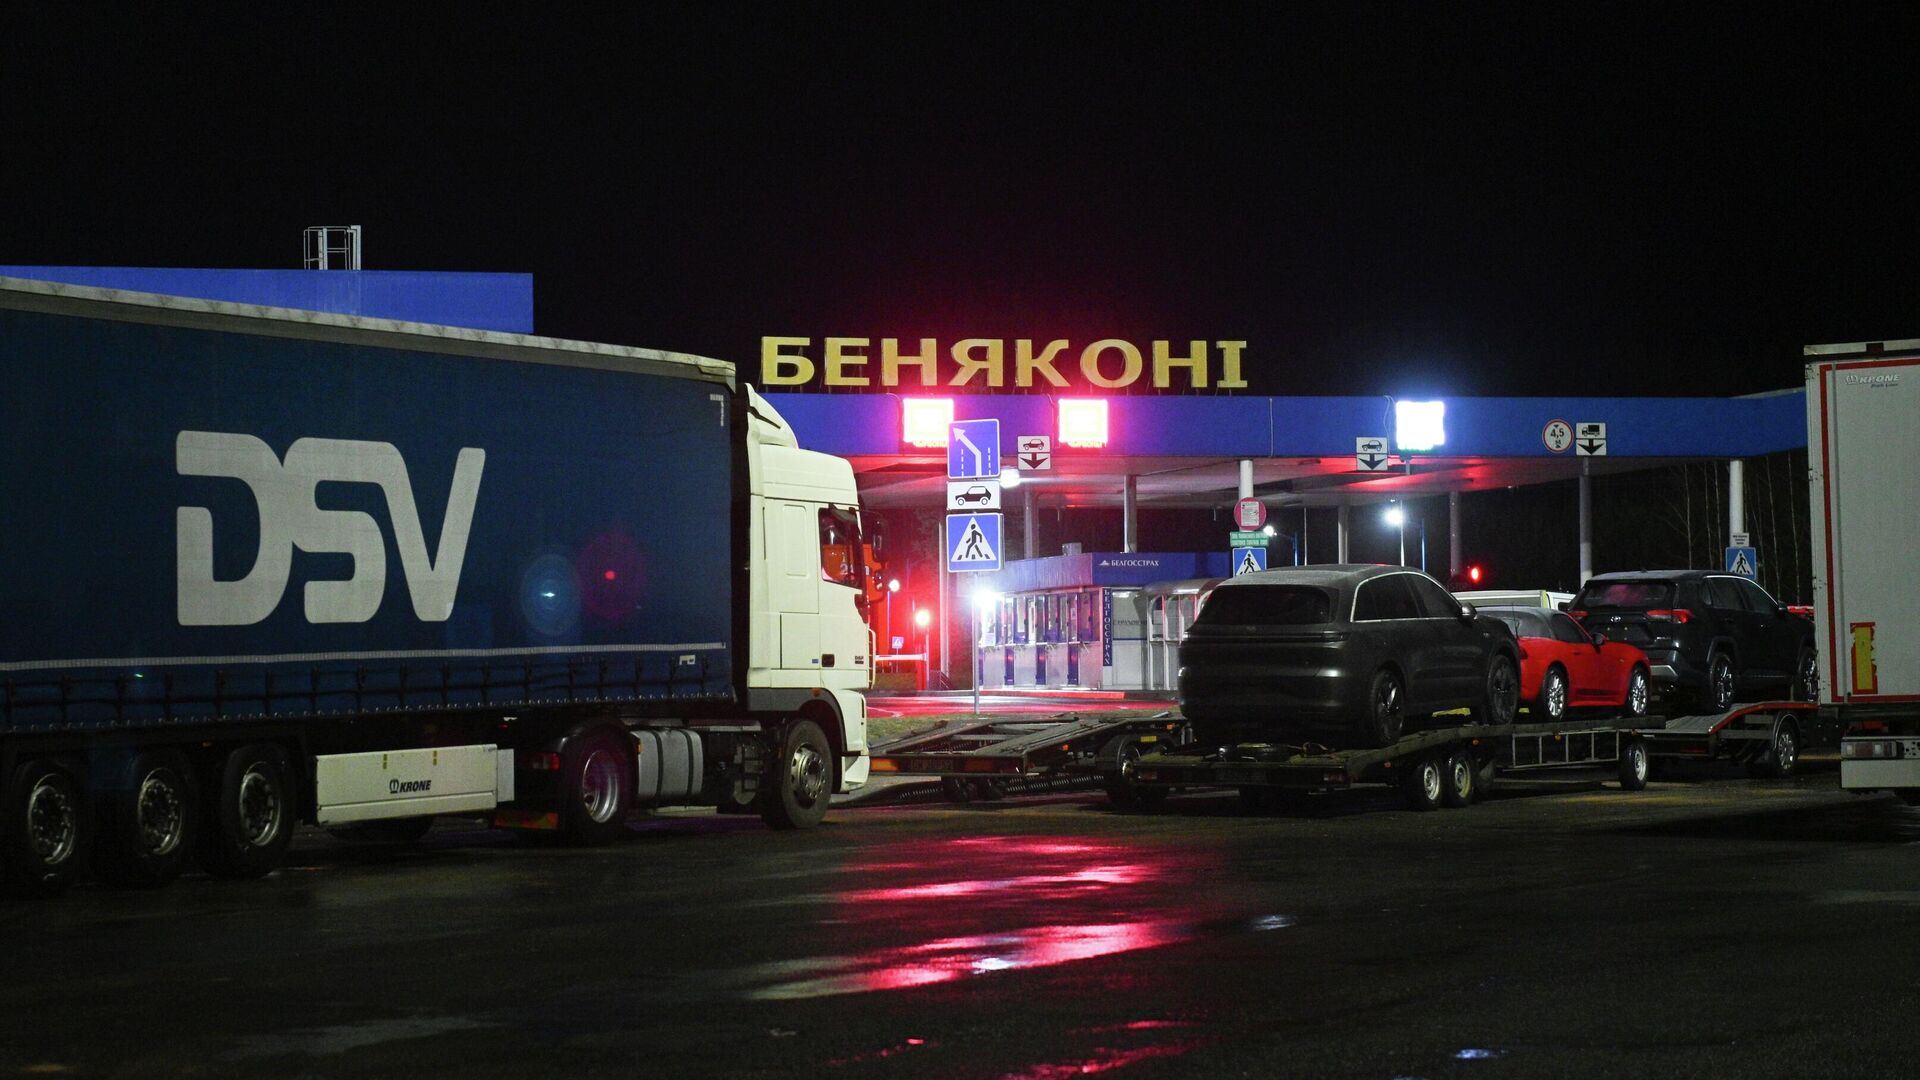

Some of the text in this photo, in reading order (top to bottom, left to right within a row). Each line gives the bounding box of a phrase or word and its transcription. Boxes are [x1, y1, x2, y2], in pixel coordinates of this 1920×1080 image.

[761, 336, 1248, 388] БЕНЯКОНІ
[1859, 374, 1900, 384] KRONE
[1550, 428, 1565, 438] 4,5
[176, 430, 486, 625] DSV
[1111, 559, 1159, 567] БЕЛГОССТРАХ
[400, 780, 431, 793] KRONE
